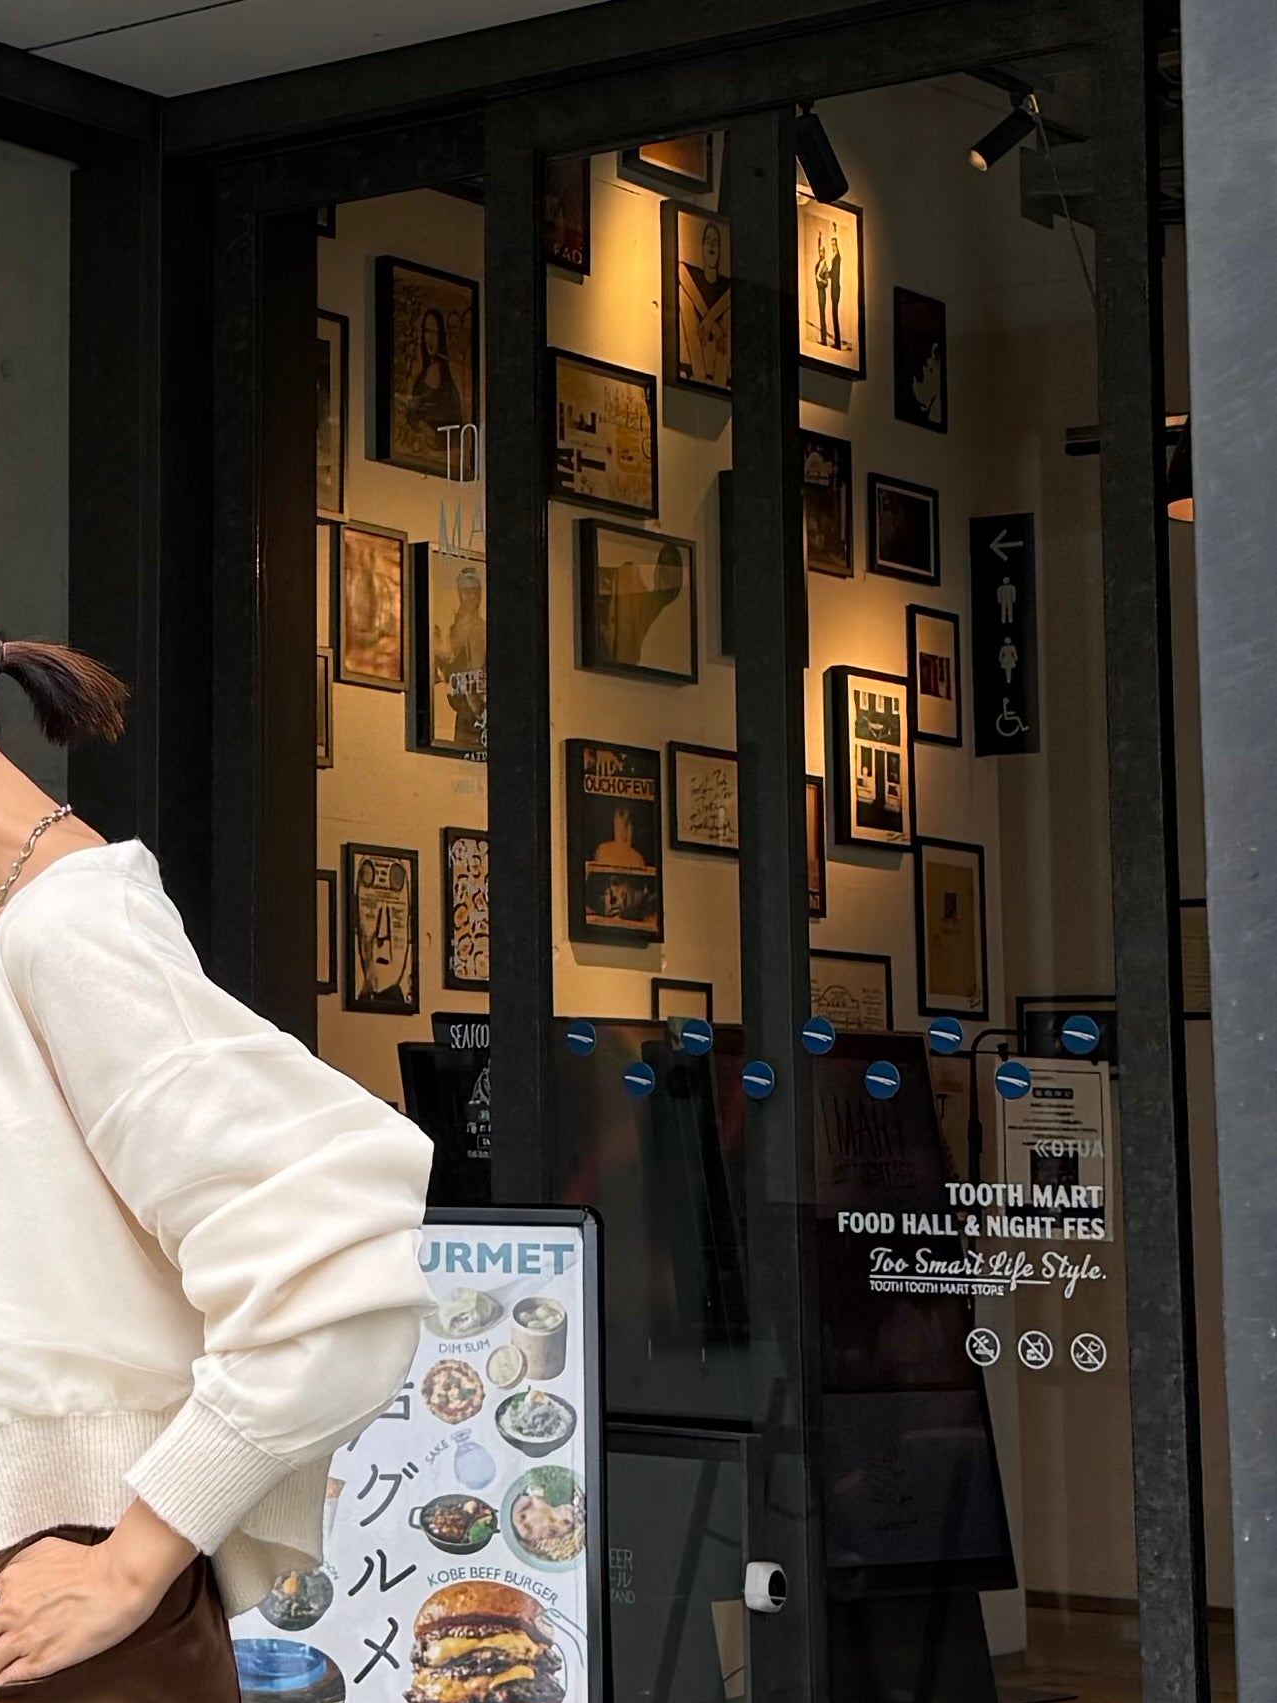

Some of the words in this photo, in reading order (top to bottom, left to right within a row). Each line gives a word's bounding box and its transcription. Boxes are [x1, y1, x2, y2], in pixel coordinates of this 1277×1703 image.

[945, 1182, 1023, 1208] TOOTH
[1033, 1183, 1104, 1209] MART
[837, 1211, 895, 1235] FOOD
[903, 1212, 959, 1237] HALL
[964, 1216, 981, 1237] &
[986, 1215, 1056, 1240] NIGHT
[1063, 1217, 1106, 1241] FES
[869, 1246, 910, 1273] Too
[914, 1247, 985, 1276] Smart
[988, 1250, 1036, 1292] Life
[1041, 1251, 1107, 1299] Style.
[869, 1279, 904, 1293] TOOTH
[904, 1280, 939, 1294] TOOTH
[939, 1281, 970, 1296] MART
[970, 1283, 1005, 1297] STORE
[438, 1343, 462, 1354] DIM
[464, 1338, 491, 1353] SUM
[425, 1439, 450, 1465] SAKE
[426, 1566, 467, 1588] KOBE
[469, 1566, 502, 1580] BEEF
[503, 1570, 559, 1606] BURGER
